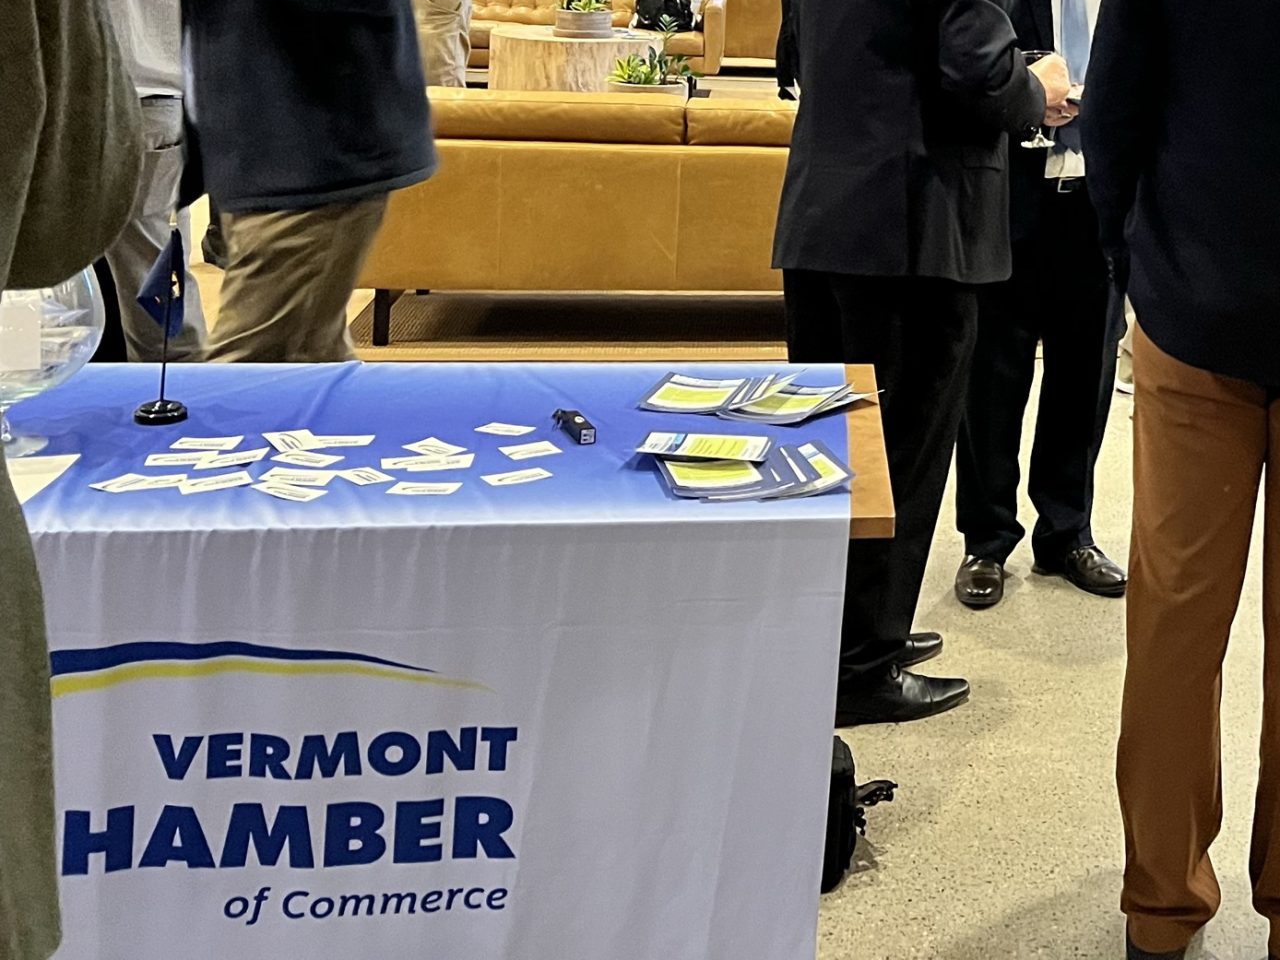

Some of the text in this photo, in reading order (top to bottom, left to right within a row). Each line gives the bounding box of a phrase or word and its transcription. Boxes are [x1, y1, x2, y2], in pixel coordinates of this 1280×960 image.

[152, 726, 518, 780] VERMONT
[61, 795, 516, 876] HAMBER
[223, 886, 508, 925] of Commerce
